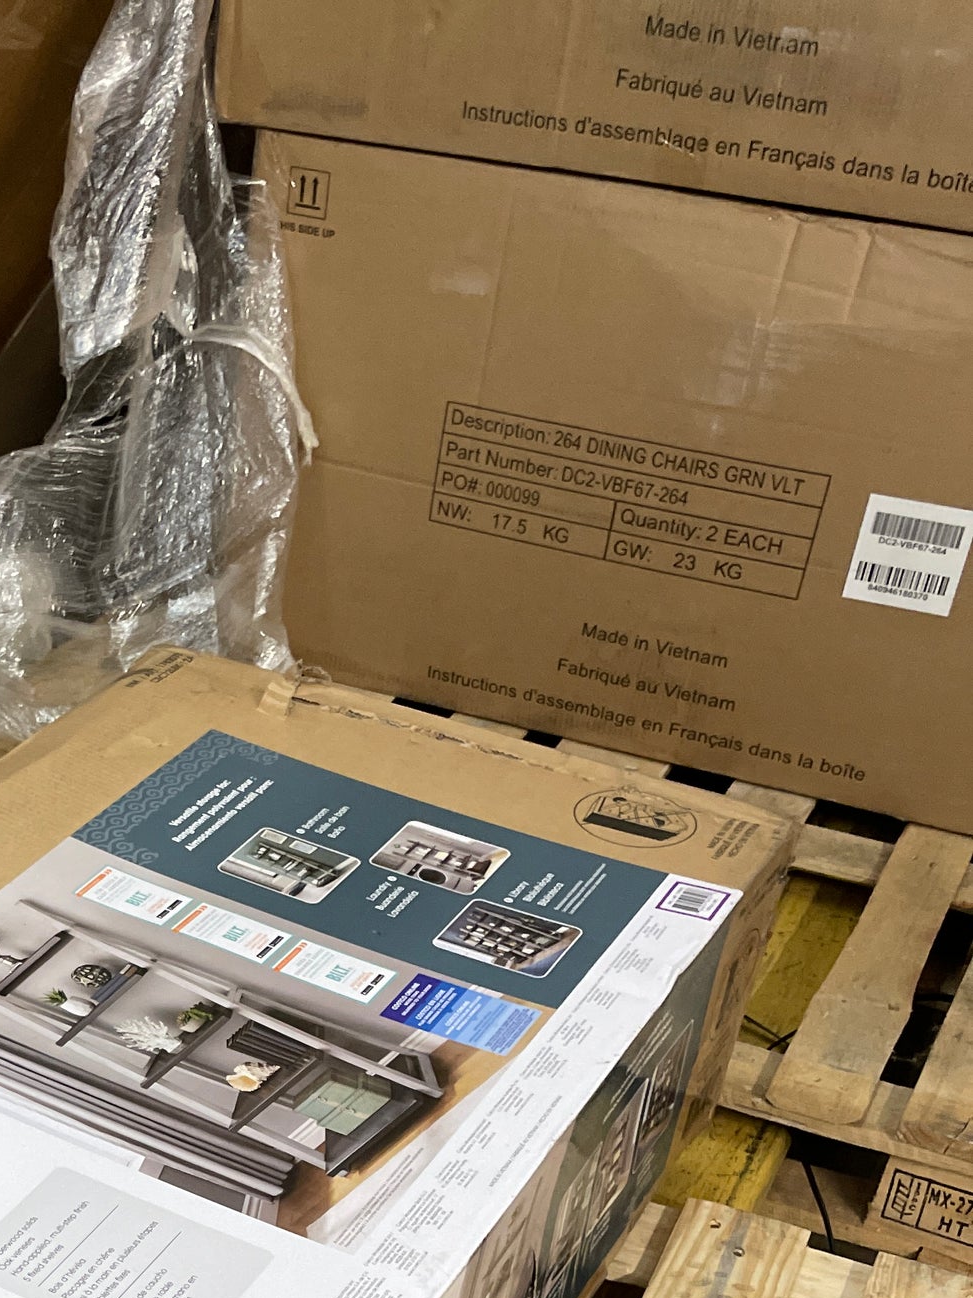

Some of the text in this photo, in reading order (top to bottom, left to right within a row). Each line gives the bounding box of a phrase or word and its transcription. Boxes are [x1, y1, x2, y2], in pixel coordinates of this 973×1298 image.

[644, 14, 819, 57] Made in Vietnam
[615, 67, 828, 116] Fabriqué au Vietnam
[462, 100, 567, 132] Instructions
[574, 116, 707, 154] d'assemblage
[714, 139, 740, 157] en
[747, 139, 835, 171] Français
[841, 155, 893, 181] dans
[900, 163, 919, 185] la
[298, 224, 320, 236] SIDE
[322, 228, 335, 238] UP
[445, 440, 689, 506] Part Number: DC2-VBF67-264
[450, 407, 806, 496] Description: 264 DINING CHAIRS GRN VLT
[440, 470, 540, 507] PO#: 000099
[436, 499, 569, 544] NW: 17.5 KG
[619, 507, 783, 555] Quantity: 2 EACH
[612, 539, 742, 580] GW: 23 KG
[877, 535, 947, 555] DC2-VBF67-264
[580, 621, 728, 668] Made in Vietnam
[556, 657, 736, 712] Fabriqué au Vietnam
[426, 664, 865, 781] Instructions d'assemblage en Français dans la boîte
[20, 1215, 39, 1231] solids
[49, 1212, 77, 1239] multi-step
[72, 1200, 89, 1213] finish
[938, 1216, 969, 1237] HT
[11, 1236, 36, 1258] veneers
[26, 1262, 45, 1277] fixed
[41, 1243, 64, 1264] shelves
